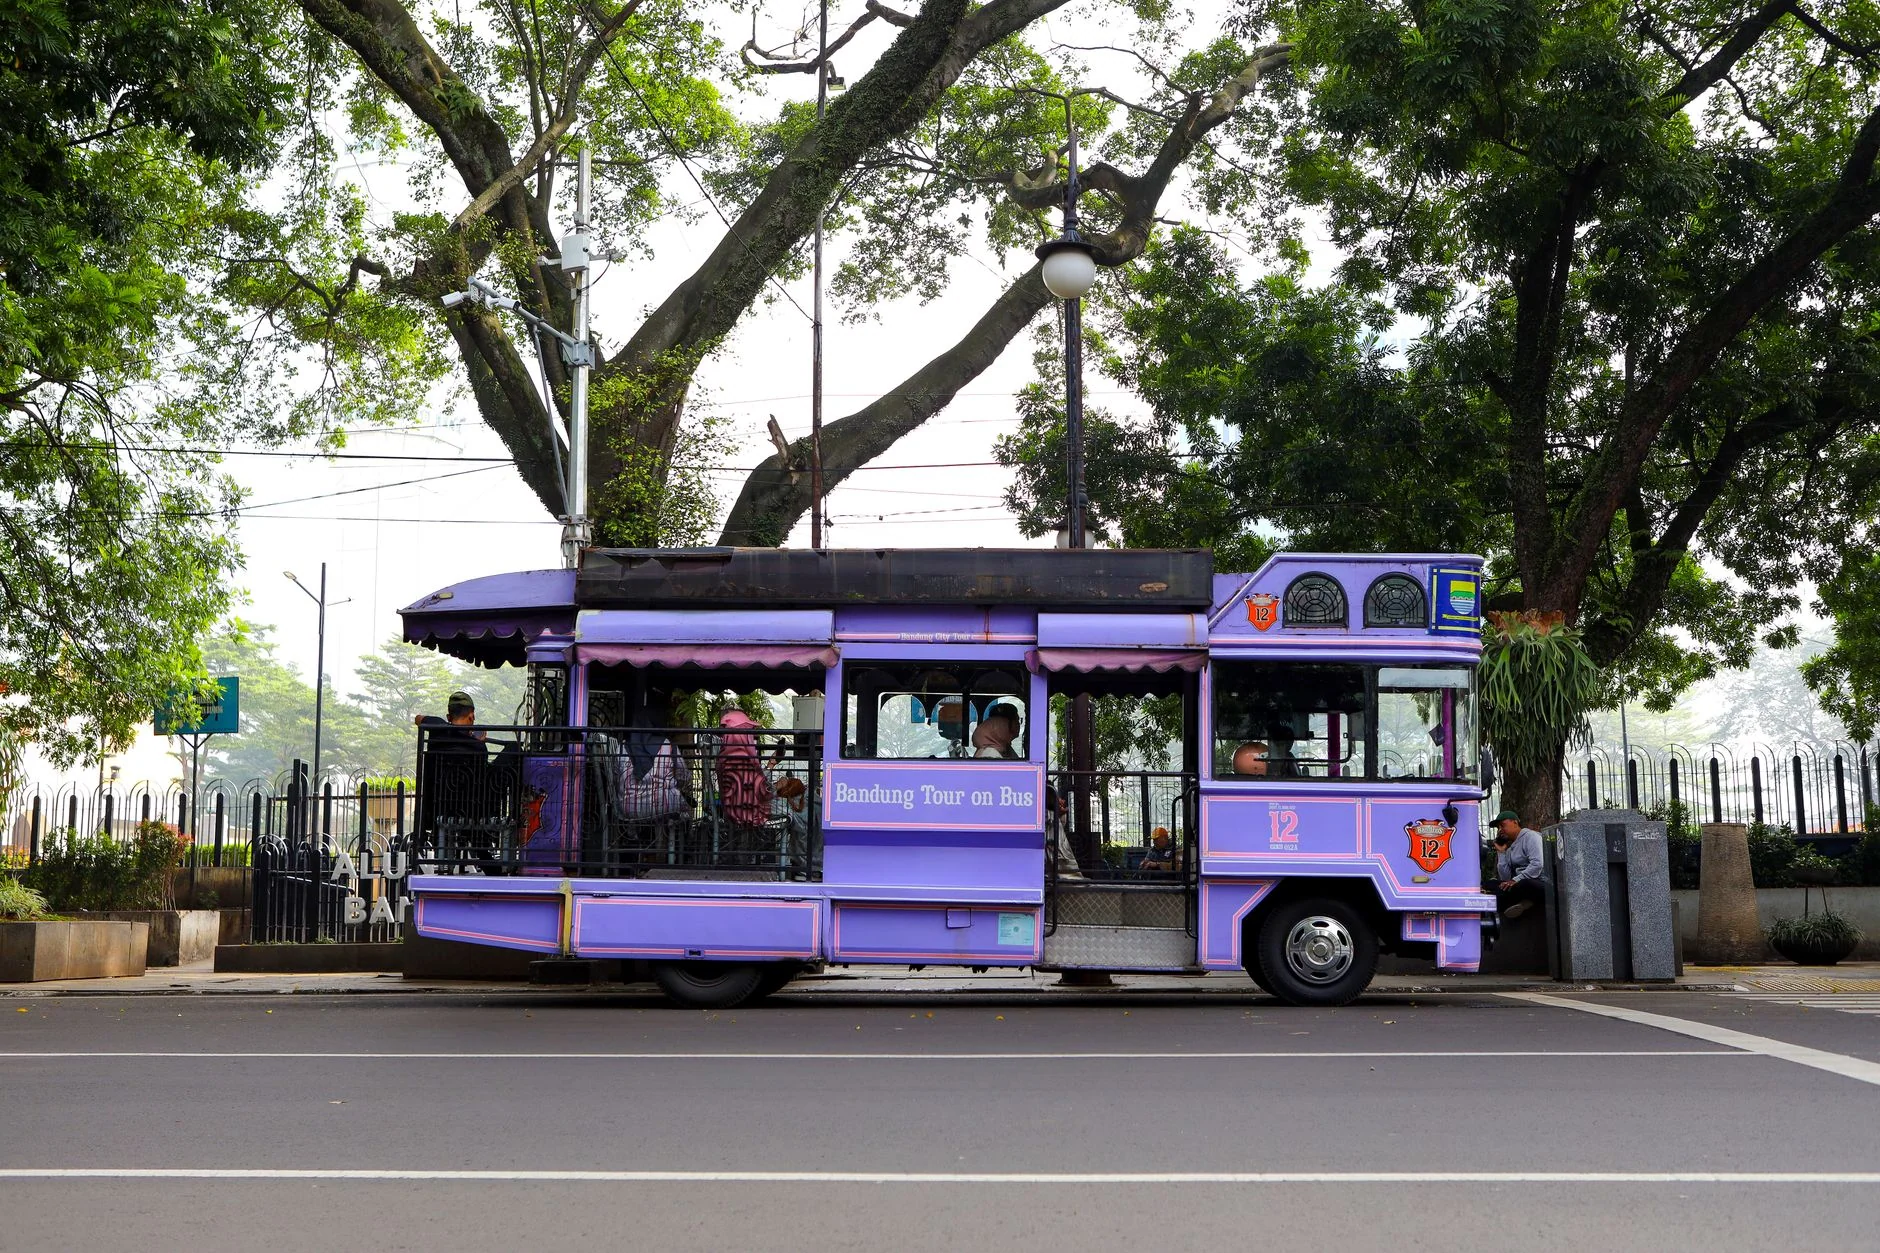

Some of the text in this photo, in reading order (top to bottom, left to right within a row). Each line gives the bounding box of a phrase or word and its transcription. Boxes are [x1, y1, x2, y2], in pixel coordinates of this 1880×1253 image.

[1255, 606, 1270, 622] 12
[901, 632, 972, 643] Bandung City Tour
[835, 782, 1034, 810] Bandung Tour on Bus
[1269, 810, 1299, 843] 12
